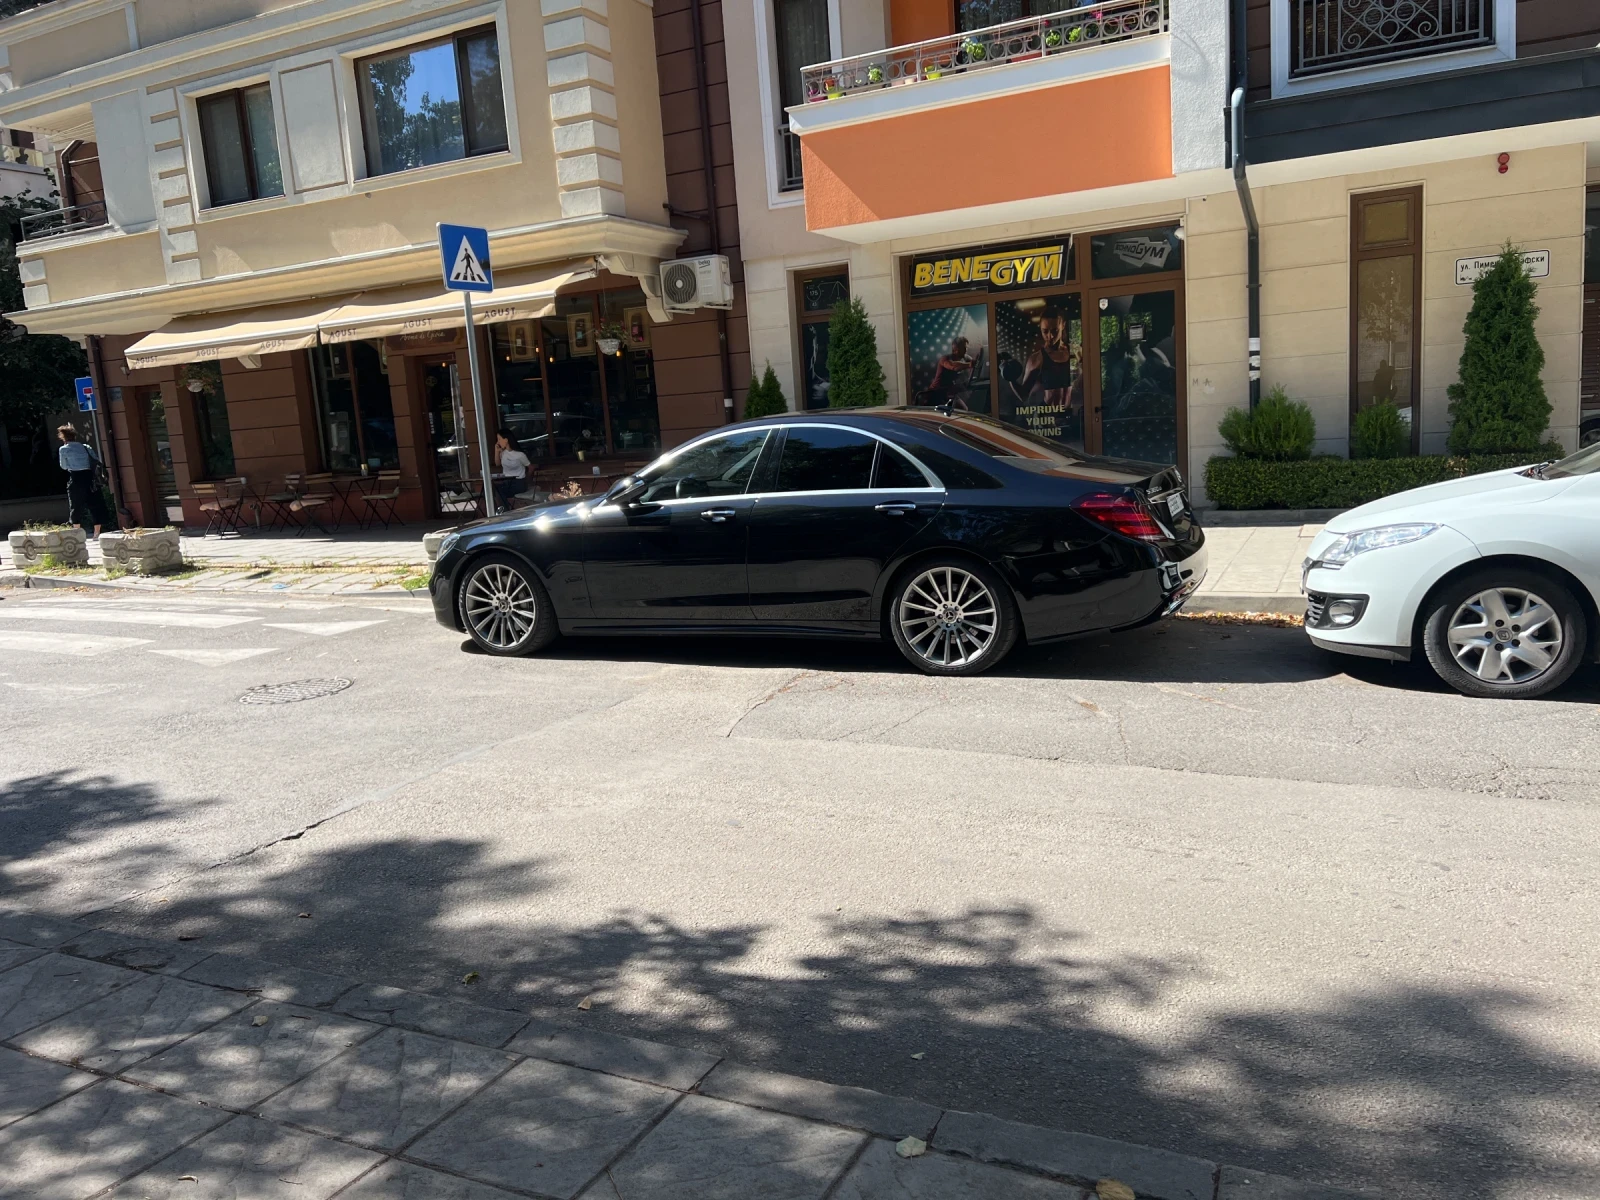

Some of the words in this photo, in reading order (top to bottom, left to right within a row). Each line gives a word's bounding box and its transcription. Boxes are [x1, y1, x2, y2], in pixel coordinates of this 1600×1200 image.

[913, 245, 1063, 287] BENEGYM
[1460, 264, 1470, 272] ул.
[484, 307, 515, 319] AGUST
[403, 318, 432, 329] AGUST
[330, 328, 357, 339] AGUST
[260, 340, 286, 349] AGUST
[196, 348, 219, 357] AGUST
[136, 356, 158, 364] AGUST
[1015, 404, 1066, 415] IMPROVE
[1026, 416, 1056, 426] YOUR
[1027, 427, 1062, 437] WING
